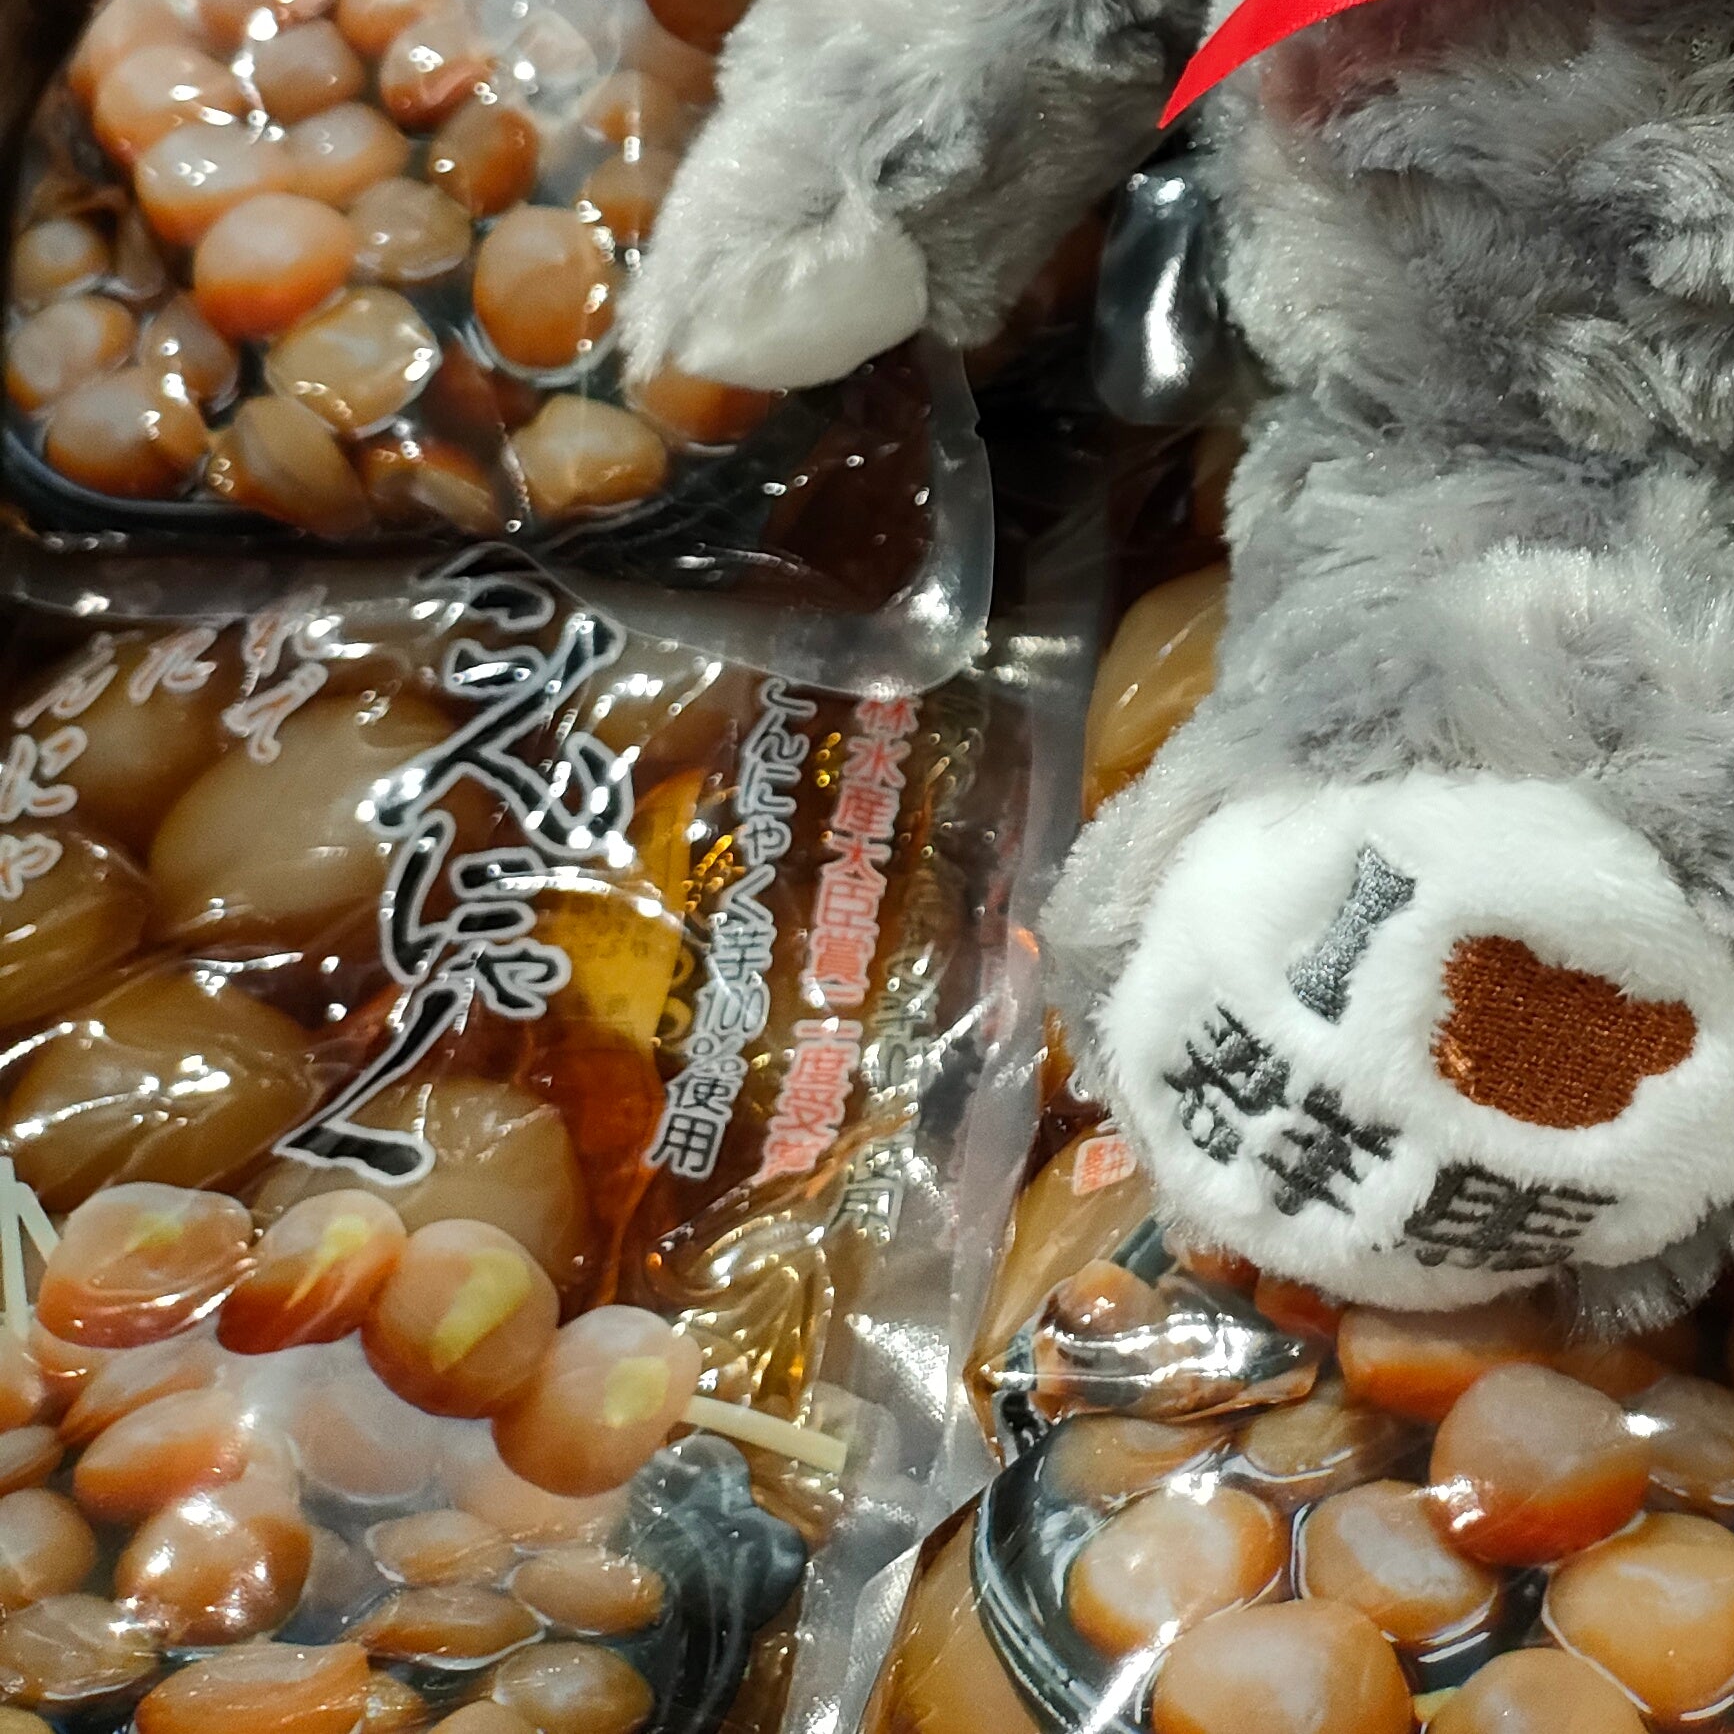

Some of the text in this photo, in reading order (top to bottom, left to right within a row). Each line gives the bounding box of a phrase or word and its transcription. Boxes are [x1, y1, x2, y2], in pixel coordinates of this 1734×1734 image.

[278, 549, 636, 1179] こんにゃく
